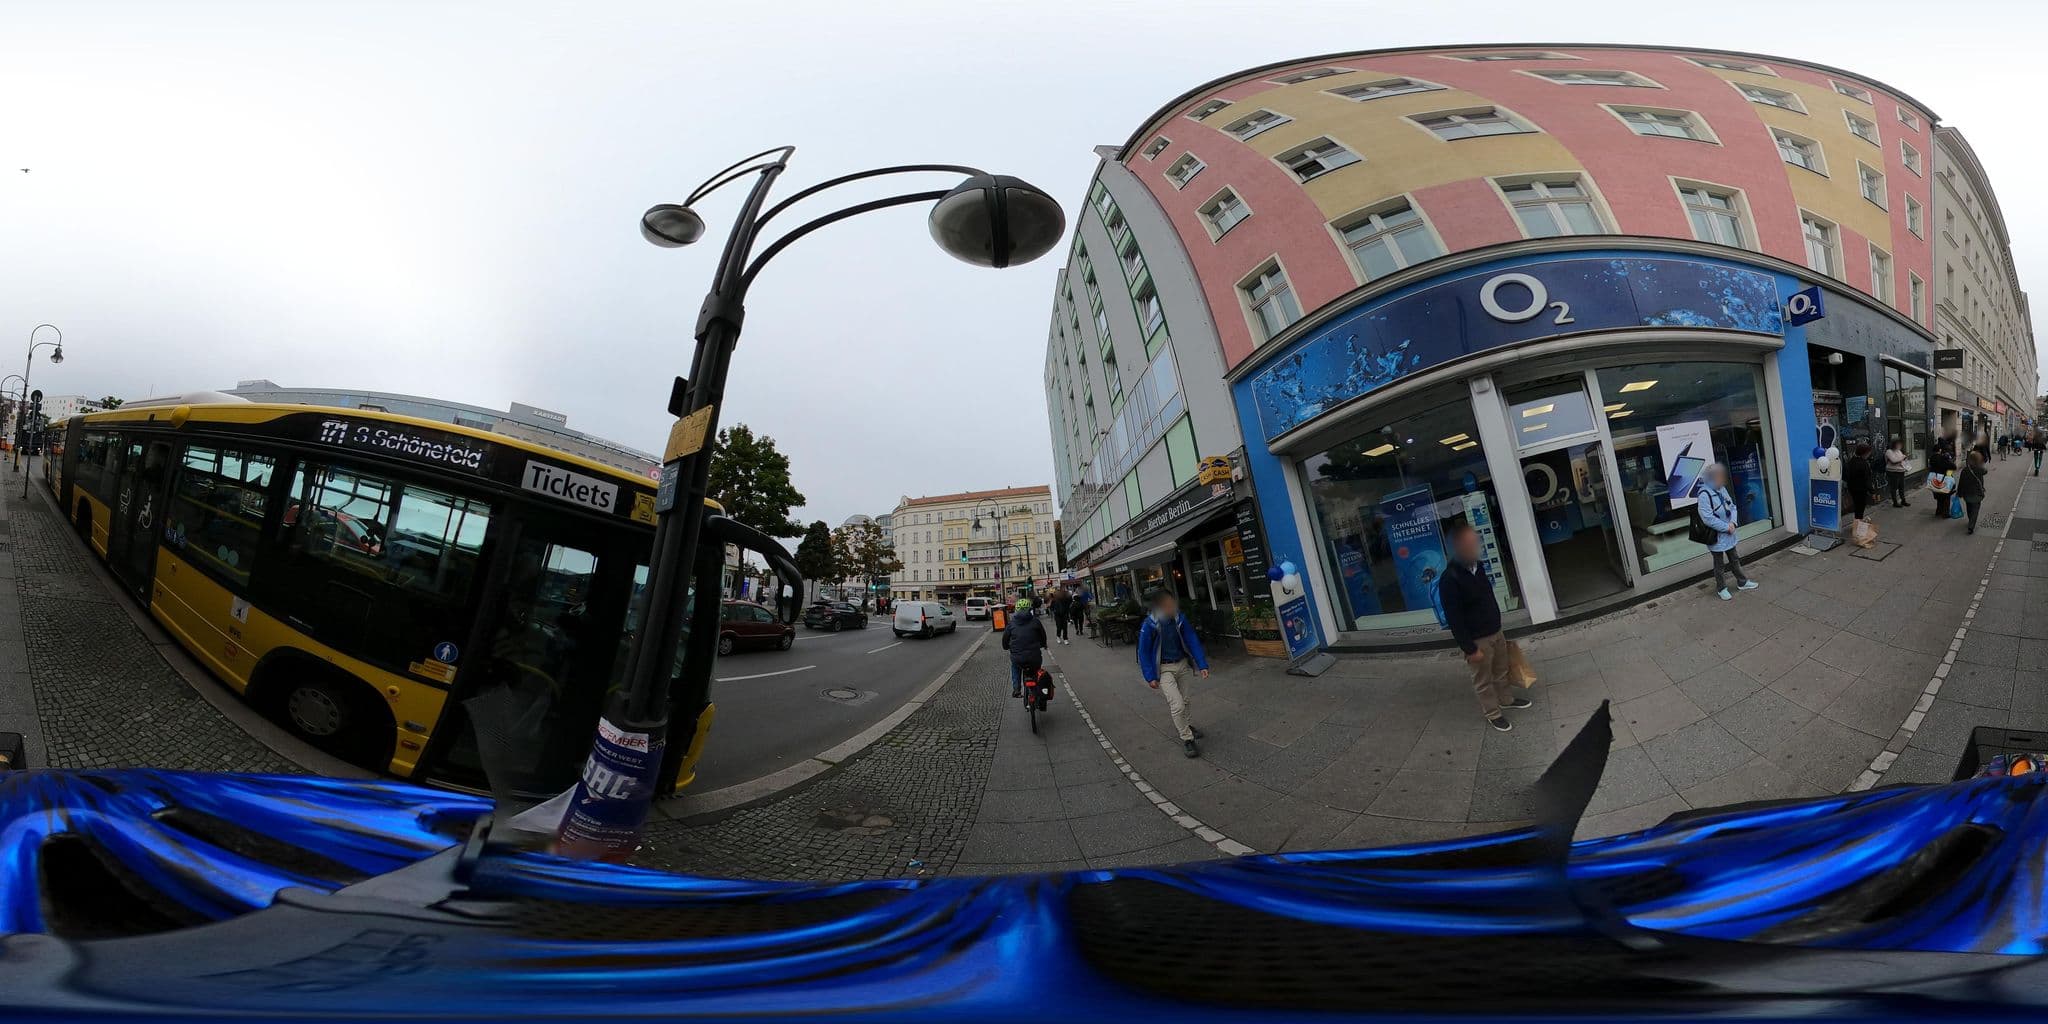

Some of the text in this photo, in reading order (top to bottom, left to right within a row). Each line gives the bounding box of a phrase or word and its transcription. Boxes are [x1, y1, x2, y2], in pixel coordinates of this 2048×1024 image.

[1480, 273, 1575, 325] O2
[1790, 294, 1817, 315] O2
[320, 420, 483, 469] 171 S Schönefeld
[532, 465, 611, 508] Tickets
[1813, 496, 1836, 506] Bonus
[1147, 499, 1192, 530] Bierbar Berlin
[1391, 516, 1430, 531] SCHNELLES
[1393, 524, 1431, 540] INTERNET
